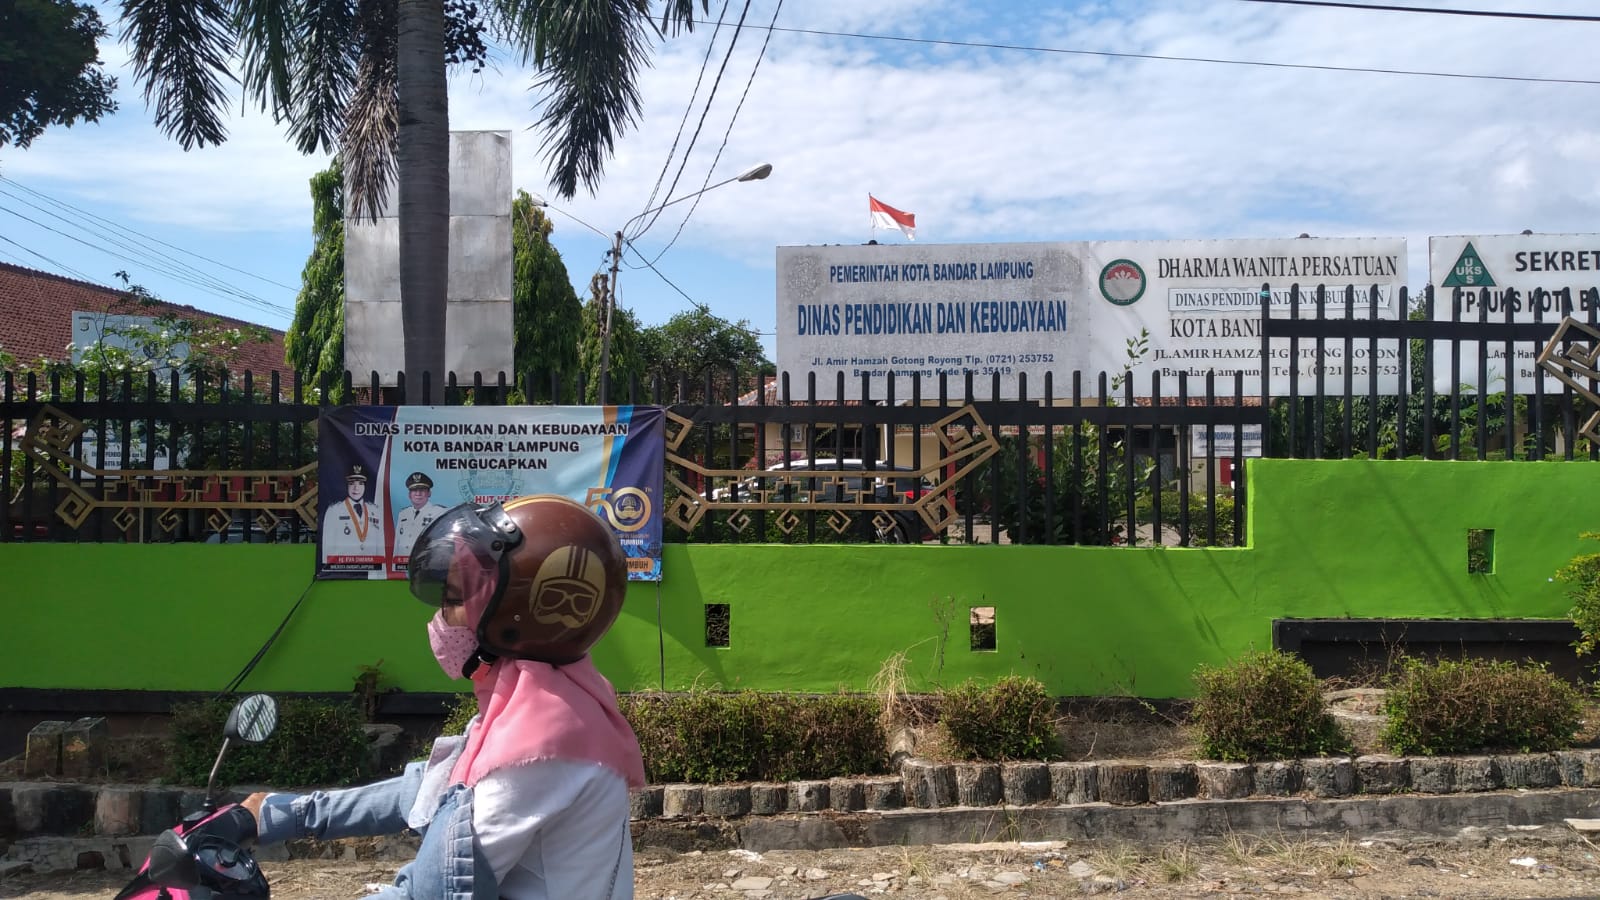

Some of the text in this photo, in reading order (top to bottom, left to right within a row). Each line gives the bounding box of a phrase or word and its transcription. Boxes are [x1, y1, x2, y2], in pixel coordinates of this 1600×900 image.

[1158, 256, 1397, 278] DHARMA WANITA PERSATUAN
[1515, 251, 1600, 272] SEKRET
[830, 261, 1034, 284] PEMERINTAH KOTA BANDAR LAMPUNG
[1175, 289, 1384, 307] DINAS PENDIDIN DN KBUDYAN
[798, 300, 1067, 335] DINAS PENDIDIKAN DAN KEBUDAYAAN
[1170, 319, 1218, 338] KOTA
[811, 353, 1054, 366] Jl. Amir Hamzah Gotong Royong Tlp. (0721) 253752
[1278, 349, 1342, 358] GTONG
[888, 368, 932, 378] ampng
[935, 367, 959, 376] Kde
[1162, 366, 1207, 377] Badar
[1353, 366, 1399, 376] 25752
[355, 422, 629, 436] DINAS PENDIDIKAN DAN KEBUDAYAAN
[403, 441, 580, 452] KOTA BANDAR LAMPUNG
[435, 458, 548, 470] MENGUCAPKAN
